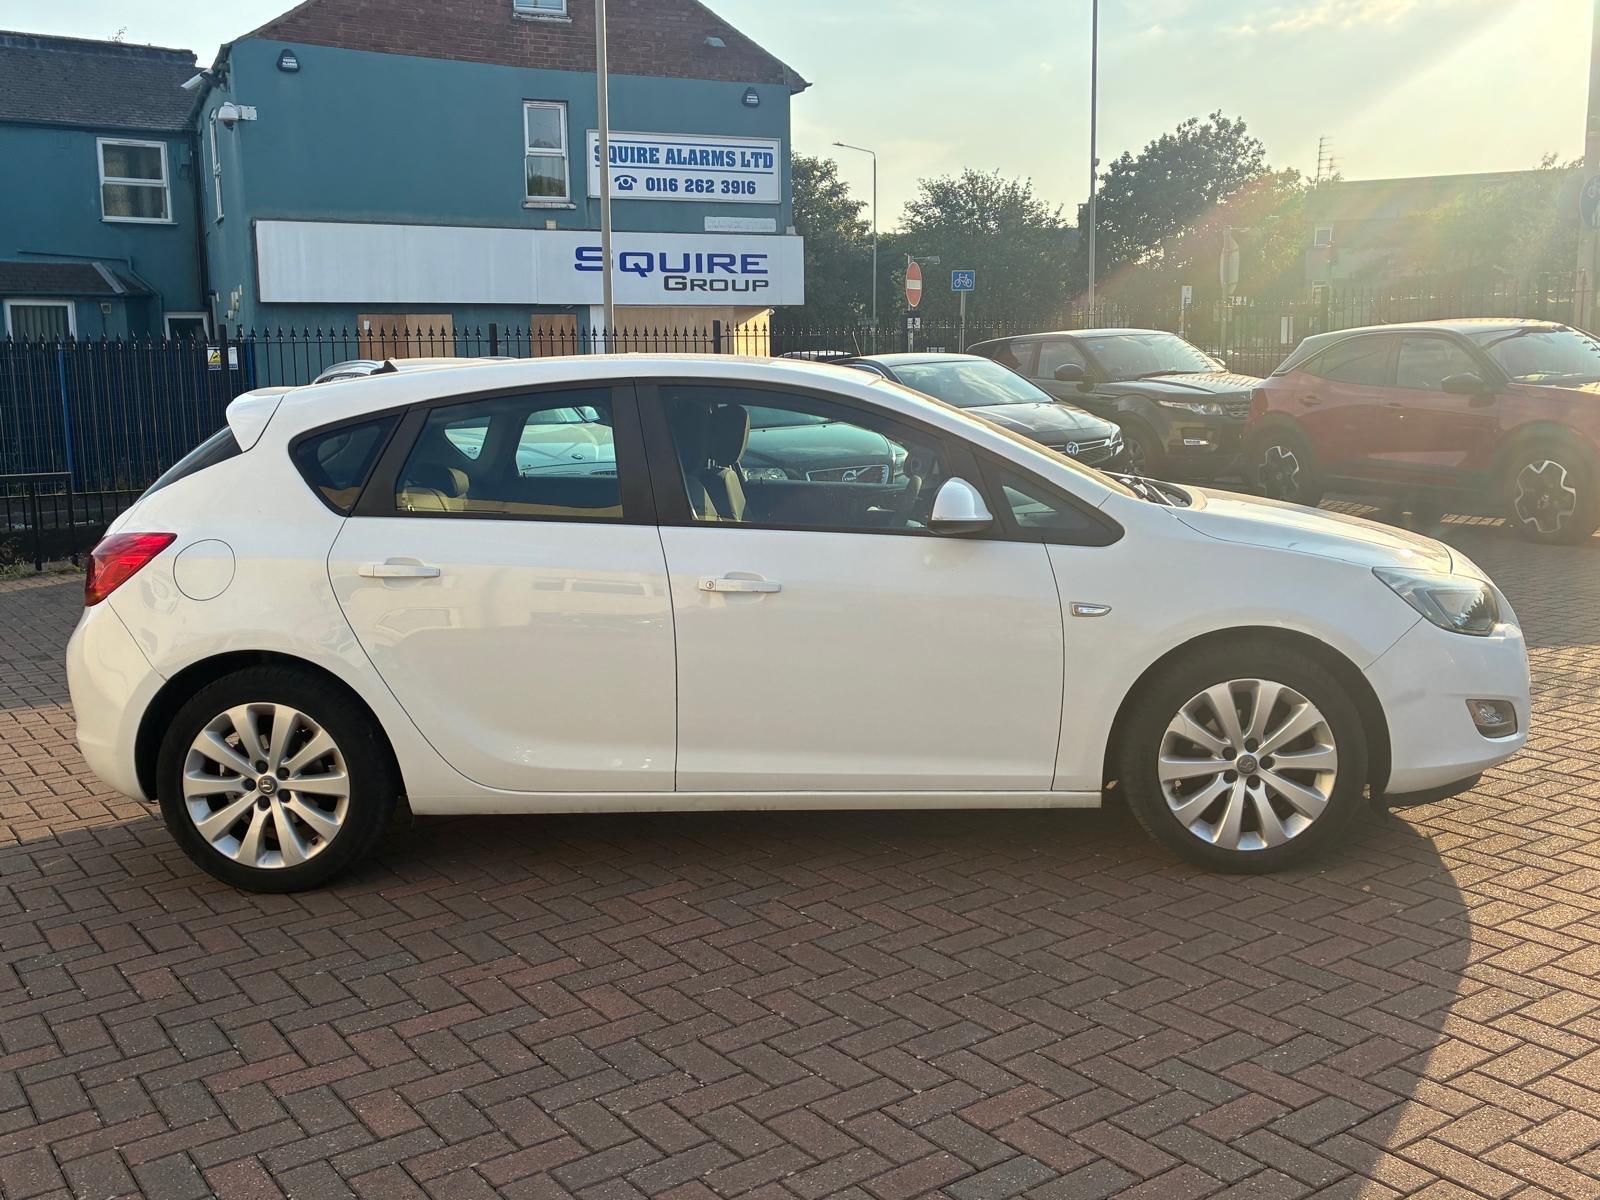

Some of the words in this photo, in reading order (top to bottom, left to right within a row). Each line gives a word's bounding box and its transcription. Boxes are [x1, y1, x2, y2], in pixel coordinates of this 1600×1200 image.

[665, 148, 736, 168] ALARMS
[740, 151, 774, 169] LTD
[645, 176, 679, 192] 0116
[684, 178, 715, 193] 262
[721, 180, 756, 195] 3916
[574, 246, 769, 277] SQUIRE
[663, 275, 769, 292] GROUP
